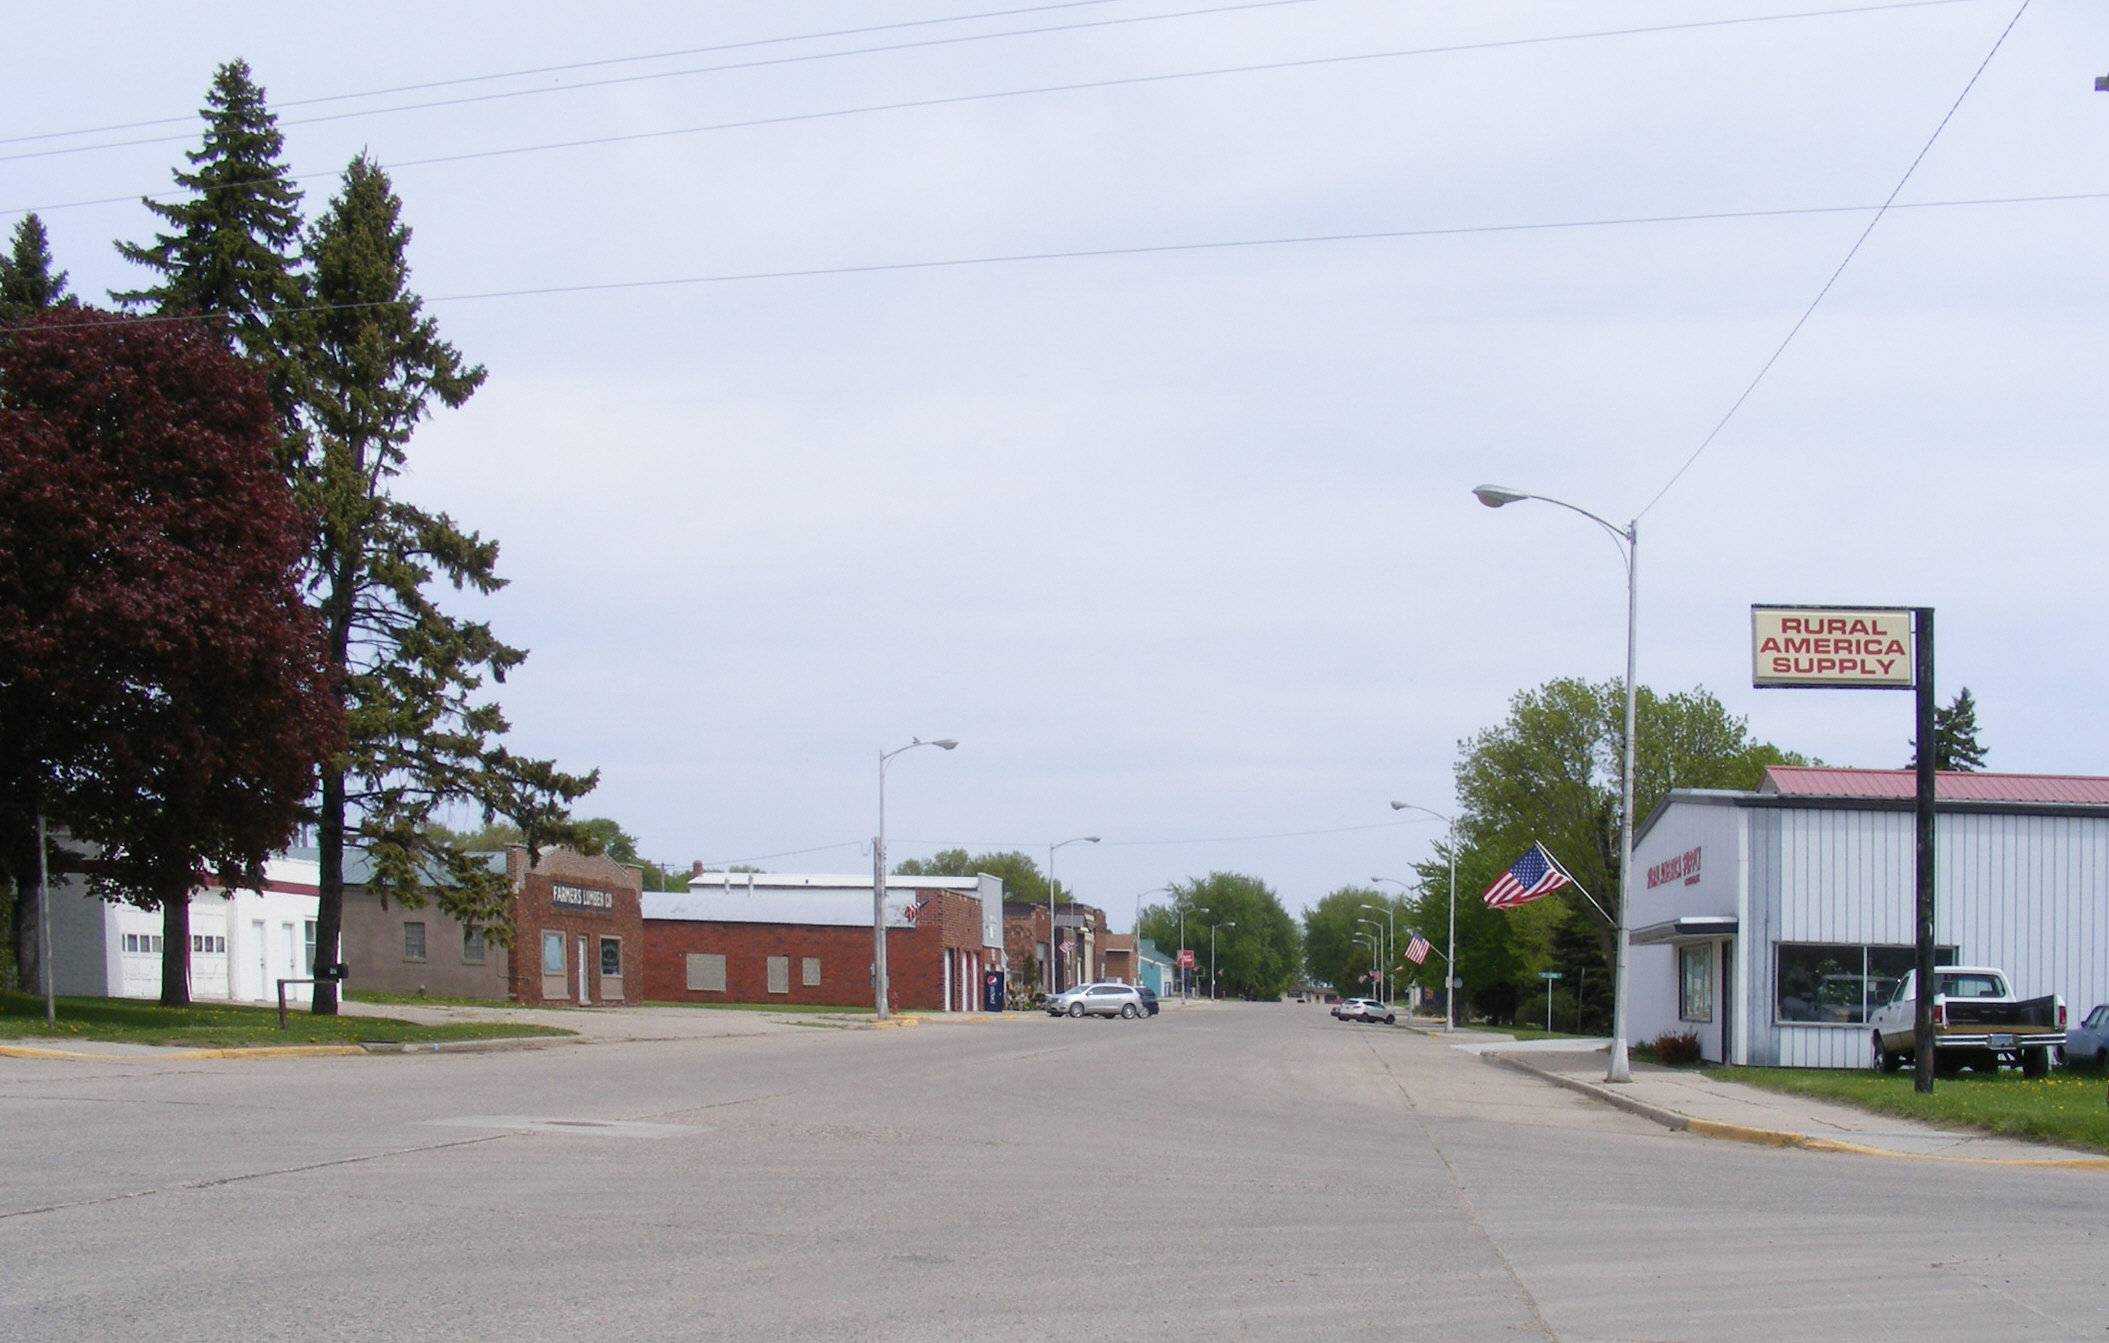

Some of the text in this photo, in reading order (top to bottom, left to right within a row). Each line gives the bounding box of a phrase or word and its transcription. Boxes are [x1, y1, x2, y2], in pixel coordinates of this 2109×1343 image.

[1780, 618, 1888, 636] RURAL
[1759, 637, 1907, 656] AMERICA
[1772, 657, 1896, 675] SUPPLY
[553, 885, 582, 905] FARMERS
[583, 889, 604, 907] LUMBER
